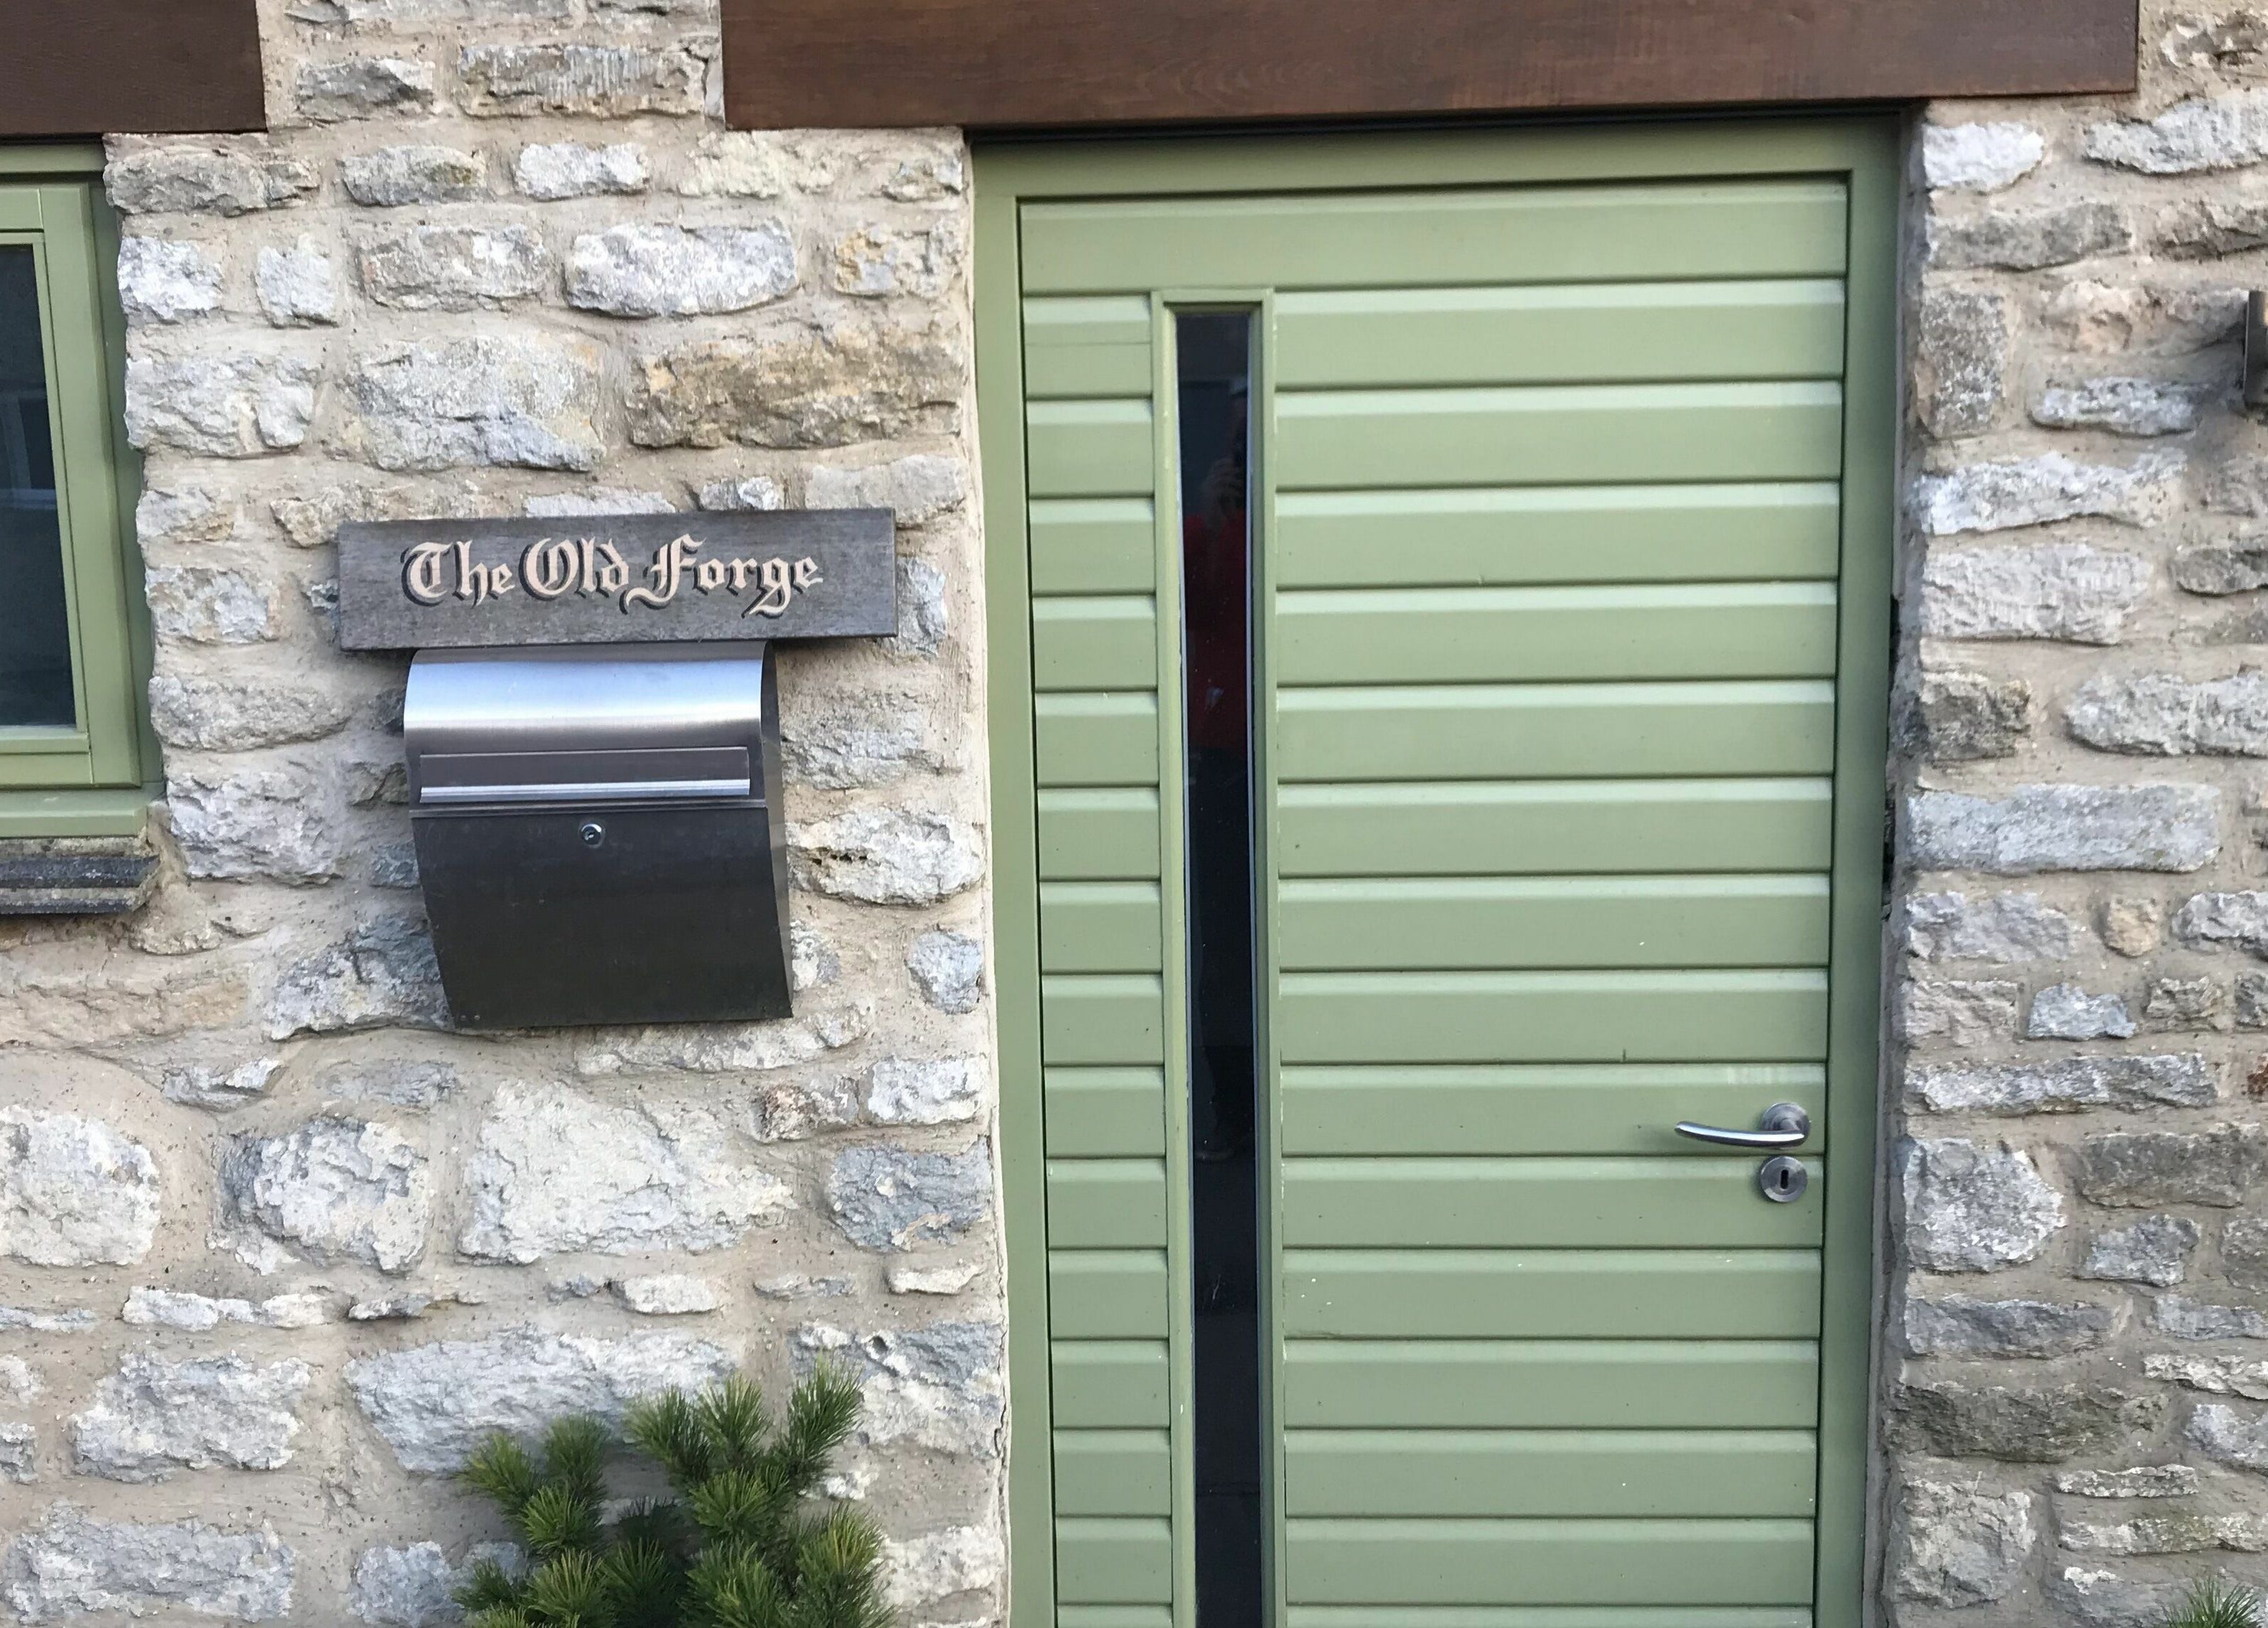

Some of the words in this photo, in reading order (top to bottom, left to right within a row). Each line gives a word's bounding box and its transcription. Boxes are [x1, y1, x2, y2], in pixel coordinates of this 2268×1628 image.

[402, 539, 516, 606] The
[520, 535, 629, 600] Old
[620, 533, 823, 618] Forge
